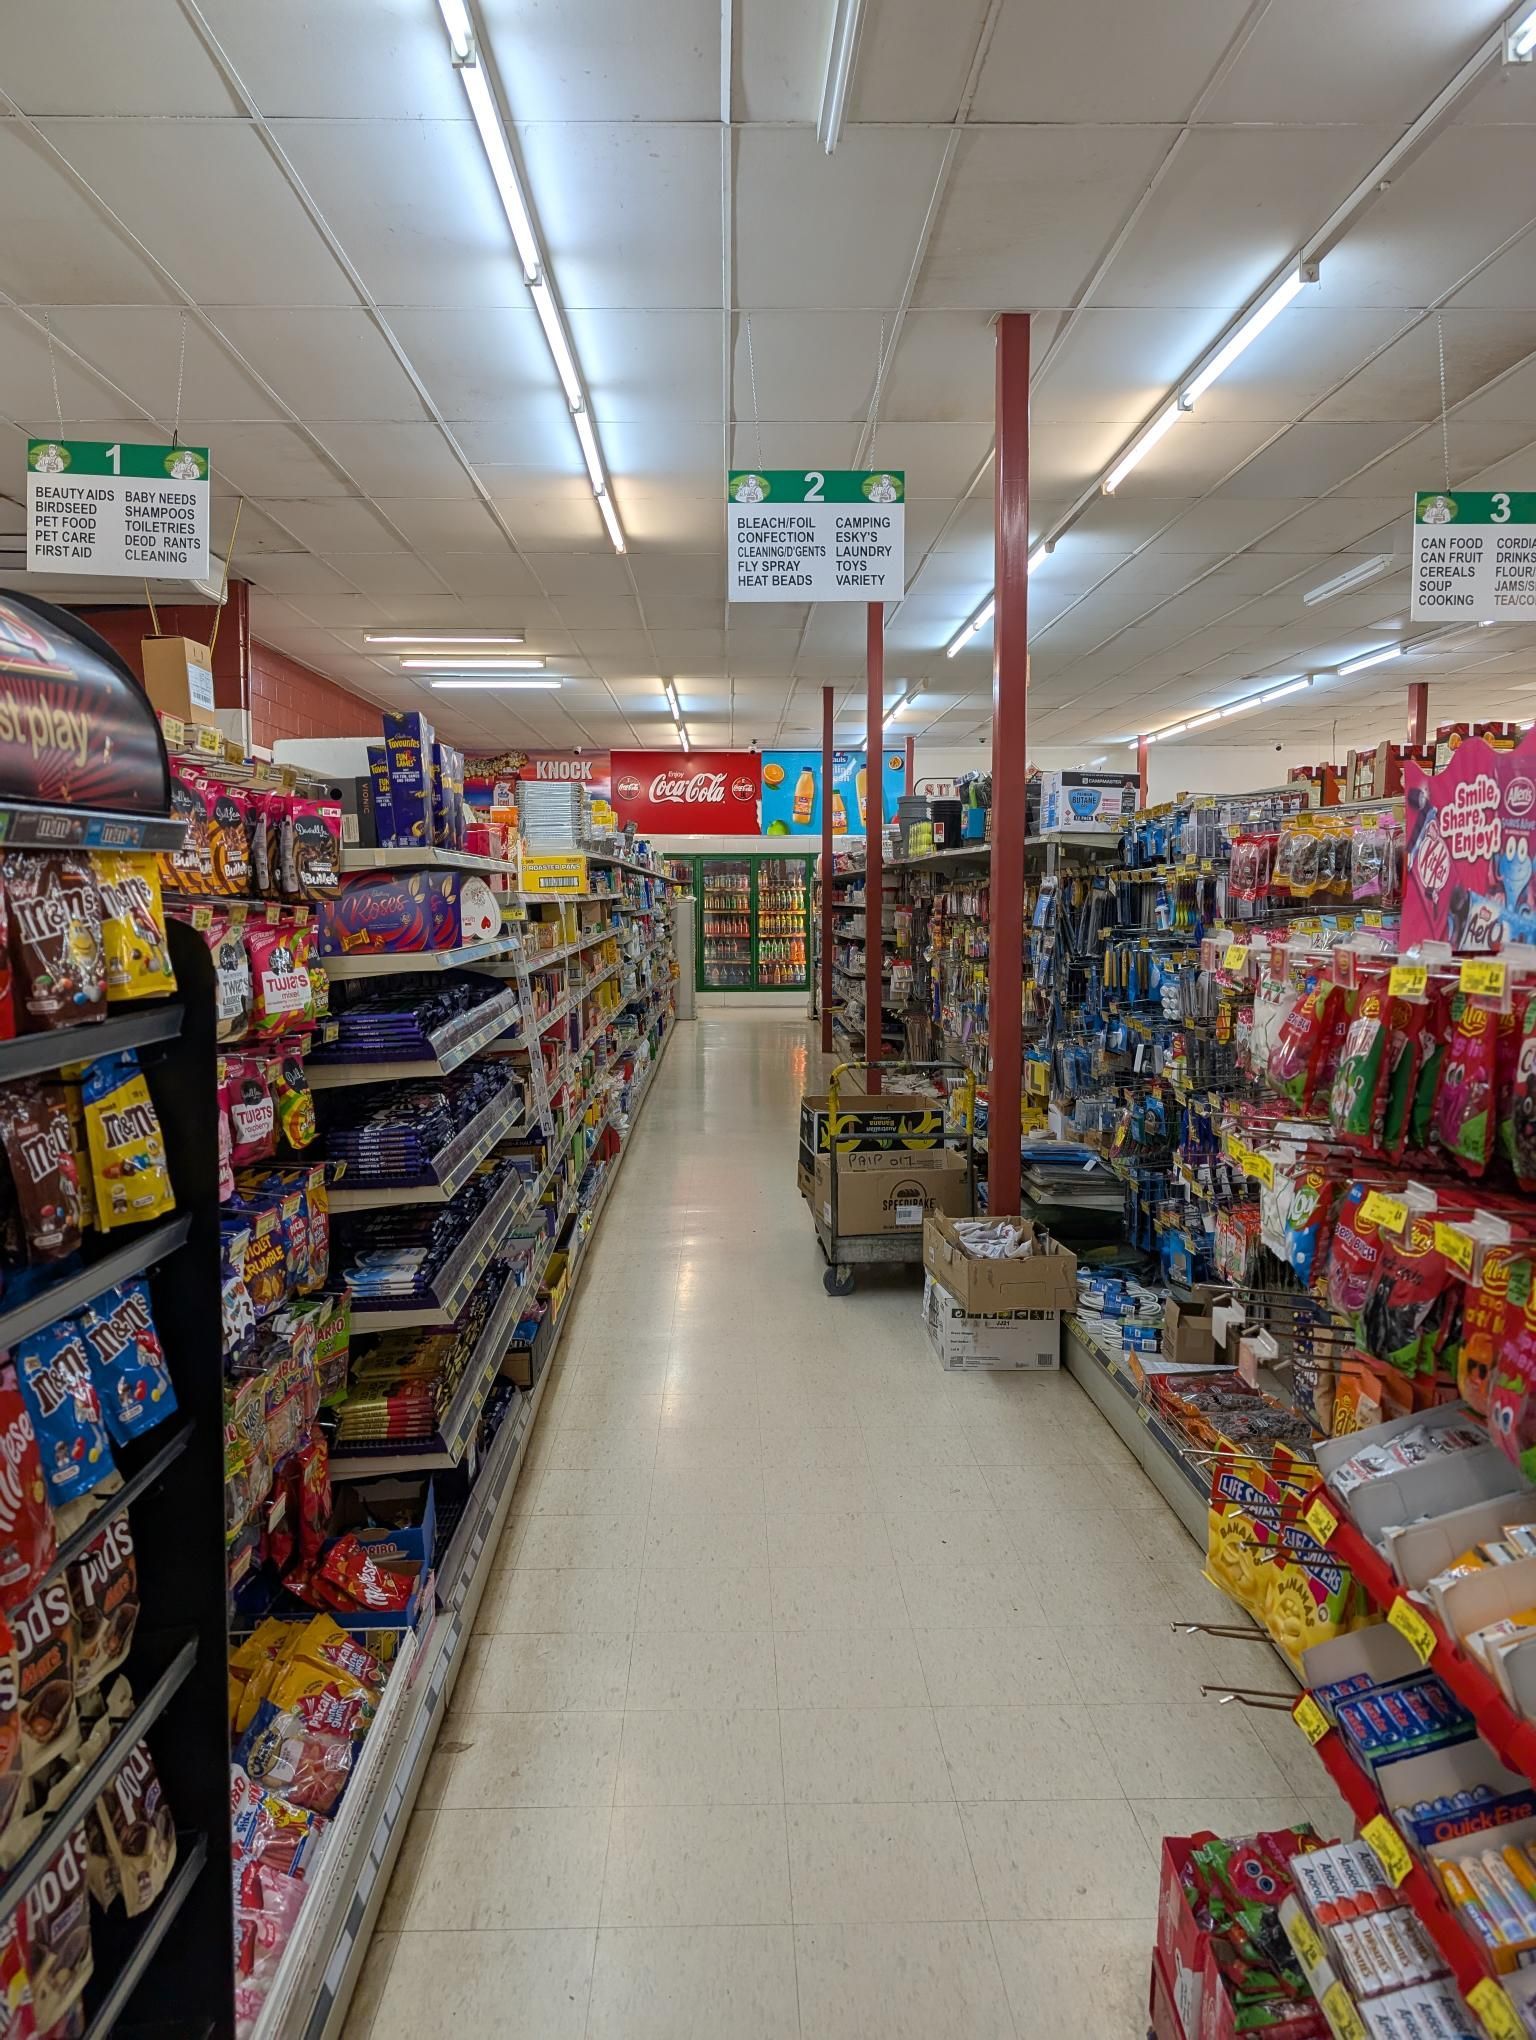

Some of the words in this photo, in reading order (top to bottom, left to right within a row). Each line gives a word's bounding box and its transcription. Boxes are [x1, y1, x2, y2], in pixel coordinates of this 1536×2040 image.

[105, 444, 121, 475] 1
[803, 471, 825, 502] 2
[35, 486, 85, 500] BEAUTY
[86, 488, 115, 502] AIDS
[125, 491, 156, 504] BABY
[159, 492, 197, 506] NEEDS
[35, 502, 98, 515] BIRDSEED
[125, 506, 195, 520] SHAMPOOS
[1490, 493, 1511, 523] 3
[35, 516, 59, 528] PET
[62, 516, 97, 530] FOOD
[125, 520, 196, 534] TOILETRIES
[737, 517, 816, 529] BLEACH/FOIL
[835, 517, 891, 528] CAMPING
[35, 530, 60, 543] PET
[61, 531, 96, 545] CARE
[125, 534, 156, 548] DEOD
[164, 536, 201, 550] RANTS
[737, 531, 815, 543] CONFECTION
[835, 531, 878, 543] ESKY'S
[1421, 538, 1446, 549] CAN
[1449, 538, 1484, 549] FOOD
[35, 545, 70, 558] FIRST
[72, 546, 92, 559] AID
[125, 549, 188, 564] CLEANING
[737, 545, 826, 558] CLEANING/D'GENTS
[835, 545, 892, 557] LAUNDRY
[1420, 552, 1446, 563] CAN
[1449, 552, 1484, 563] FRUIT
[1496, 552, 1536, 563] DRINKS
[738, 560, 758, 572] FLY
[761, 560, 801, 572] SPRAY
[835, 560, 867, 571] TOYS
[1420, 567, 1475, 577] CEREALS
[738, 575, 768, 587] HEAT
[771, 575, 813, 586] BEADS
[835, 574, 886, 586] VARIETY
[1419, 581, 1452, 592] SOUP
[1494, 580, 1536, 592] JAMS/S
[1418, 595, 1474, 606] COOKING
[1494, 594, 1536, 606] TEA/CO
[25, 692, 88, 768] play
[536, 761, 592, 780] KNOCK
[668, 771, 684, 779] Enjoy
[649, 772, 728, 803] Coca-Cola
[1458, 779, 1498, 810] Smile,
[362, 783, 370, 814] VIONIC
[1072, 796, 1097, 804] BUTANE
[1443, 809, 1483, 832] Share,
[1455, 824, 1499, 859] Enjoy!
[342, 894, 408, 922] Roses
[237, 1106, 273, 1125] TWISTS
[243, 1234, 272, 1262] VIOLET
[243, 1246, 286, 1283] CRUMBLE
[1222, 1478, 1243, 1501] LIFE
[1278, 1578, 1314, 1627] BANANAS
[1320, 1862, 1344, 1894] Anticol
[1339, 1857, 1365, 1889] Anticol
[1302, 1866, 1326, 1900] Anticol
